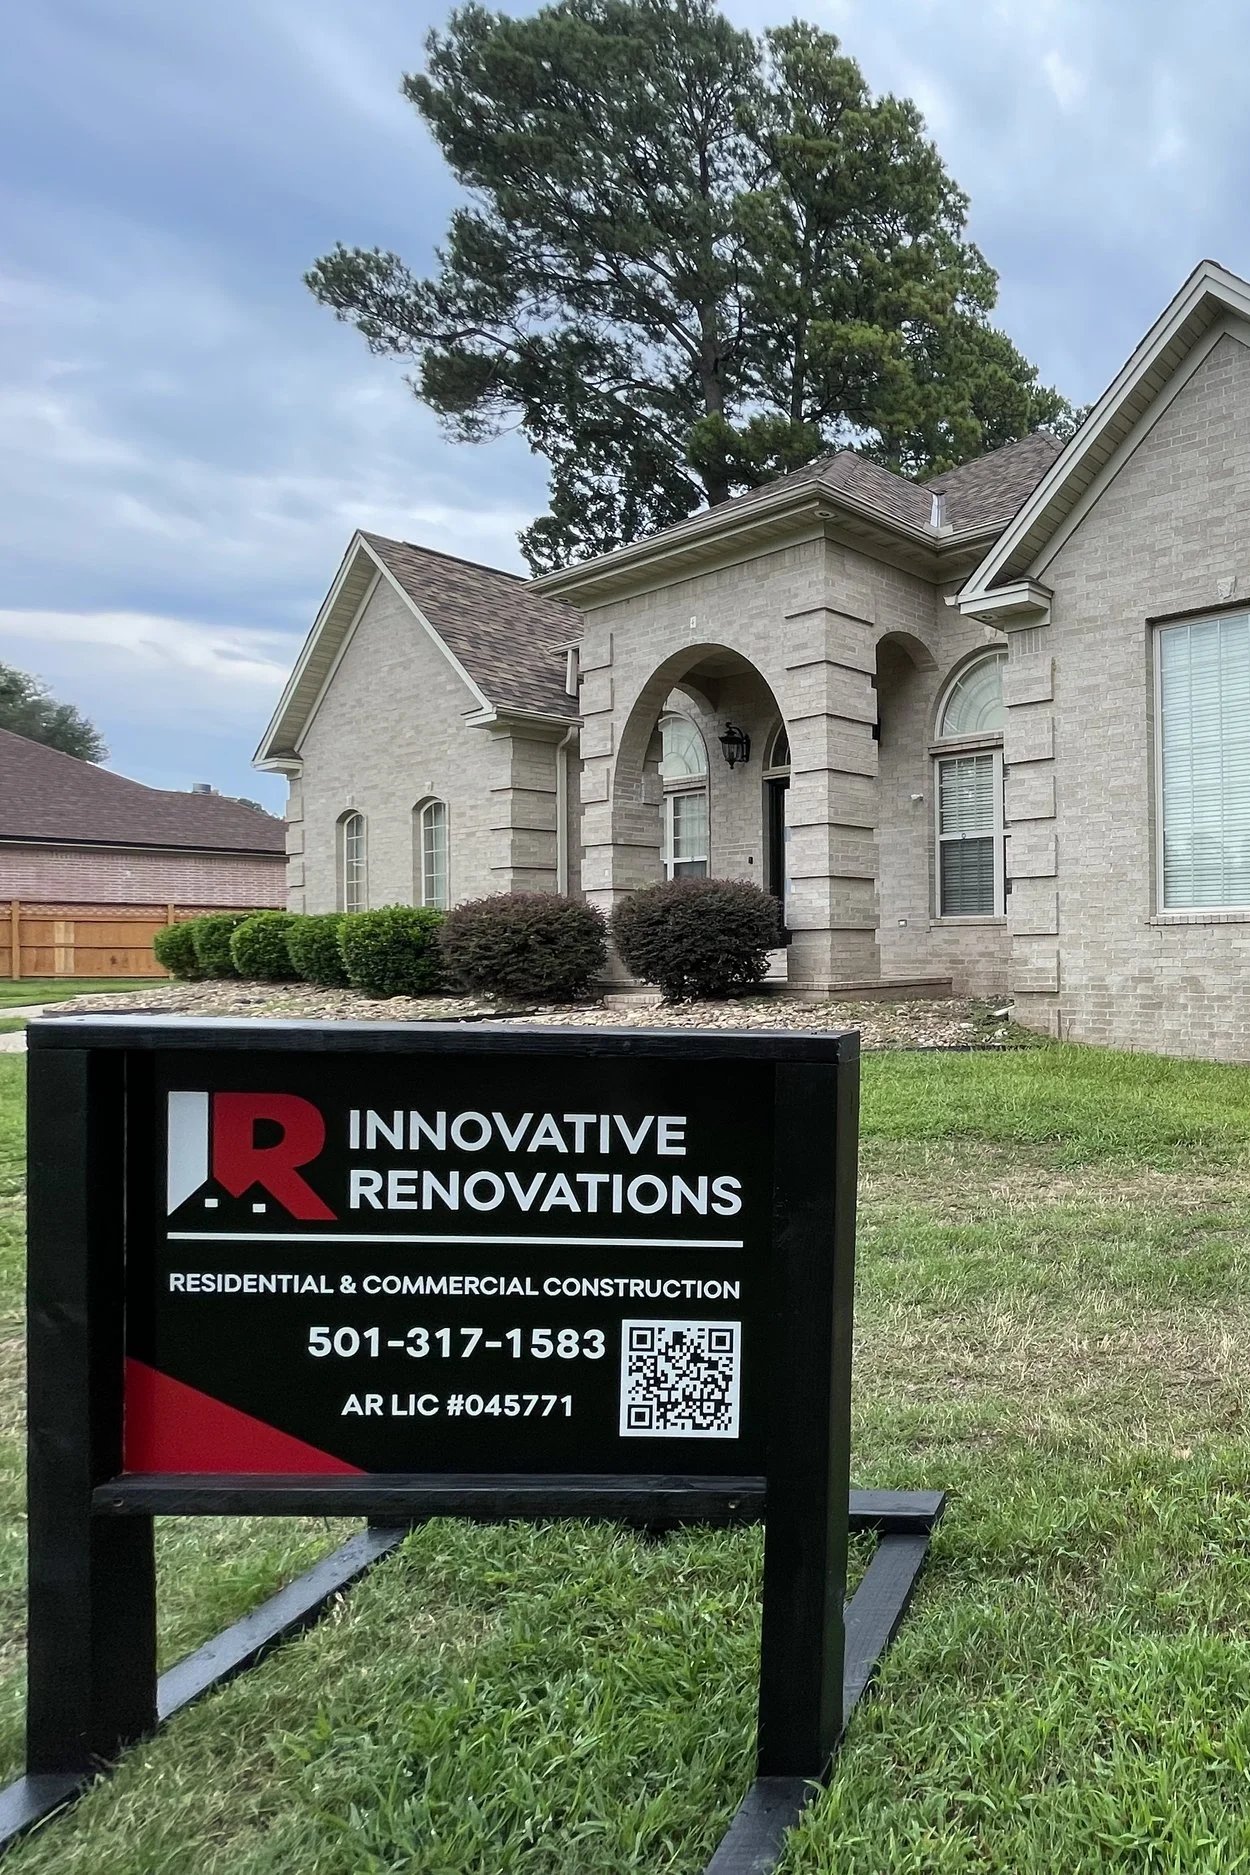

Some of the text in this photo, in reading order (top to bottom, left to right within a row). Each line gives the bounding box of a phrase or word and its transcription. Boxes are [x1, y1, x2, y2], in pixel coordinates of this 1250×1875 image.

[349, 1109, 687, 1155] INNOVATIVE
[349, 1169, 743, 1216] RENOVATIONS
[168, 1273, 741, 1300] RESIDENTIAL & COMMERCIAL CONSTRUCTION
[307, 1326, 607, 1360] 501-317-1583
[341, 1394, 574, 1418] AR LIC #045771
